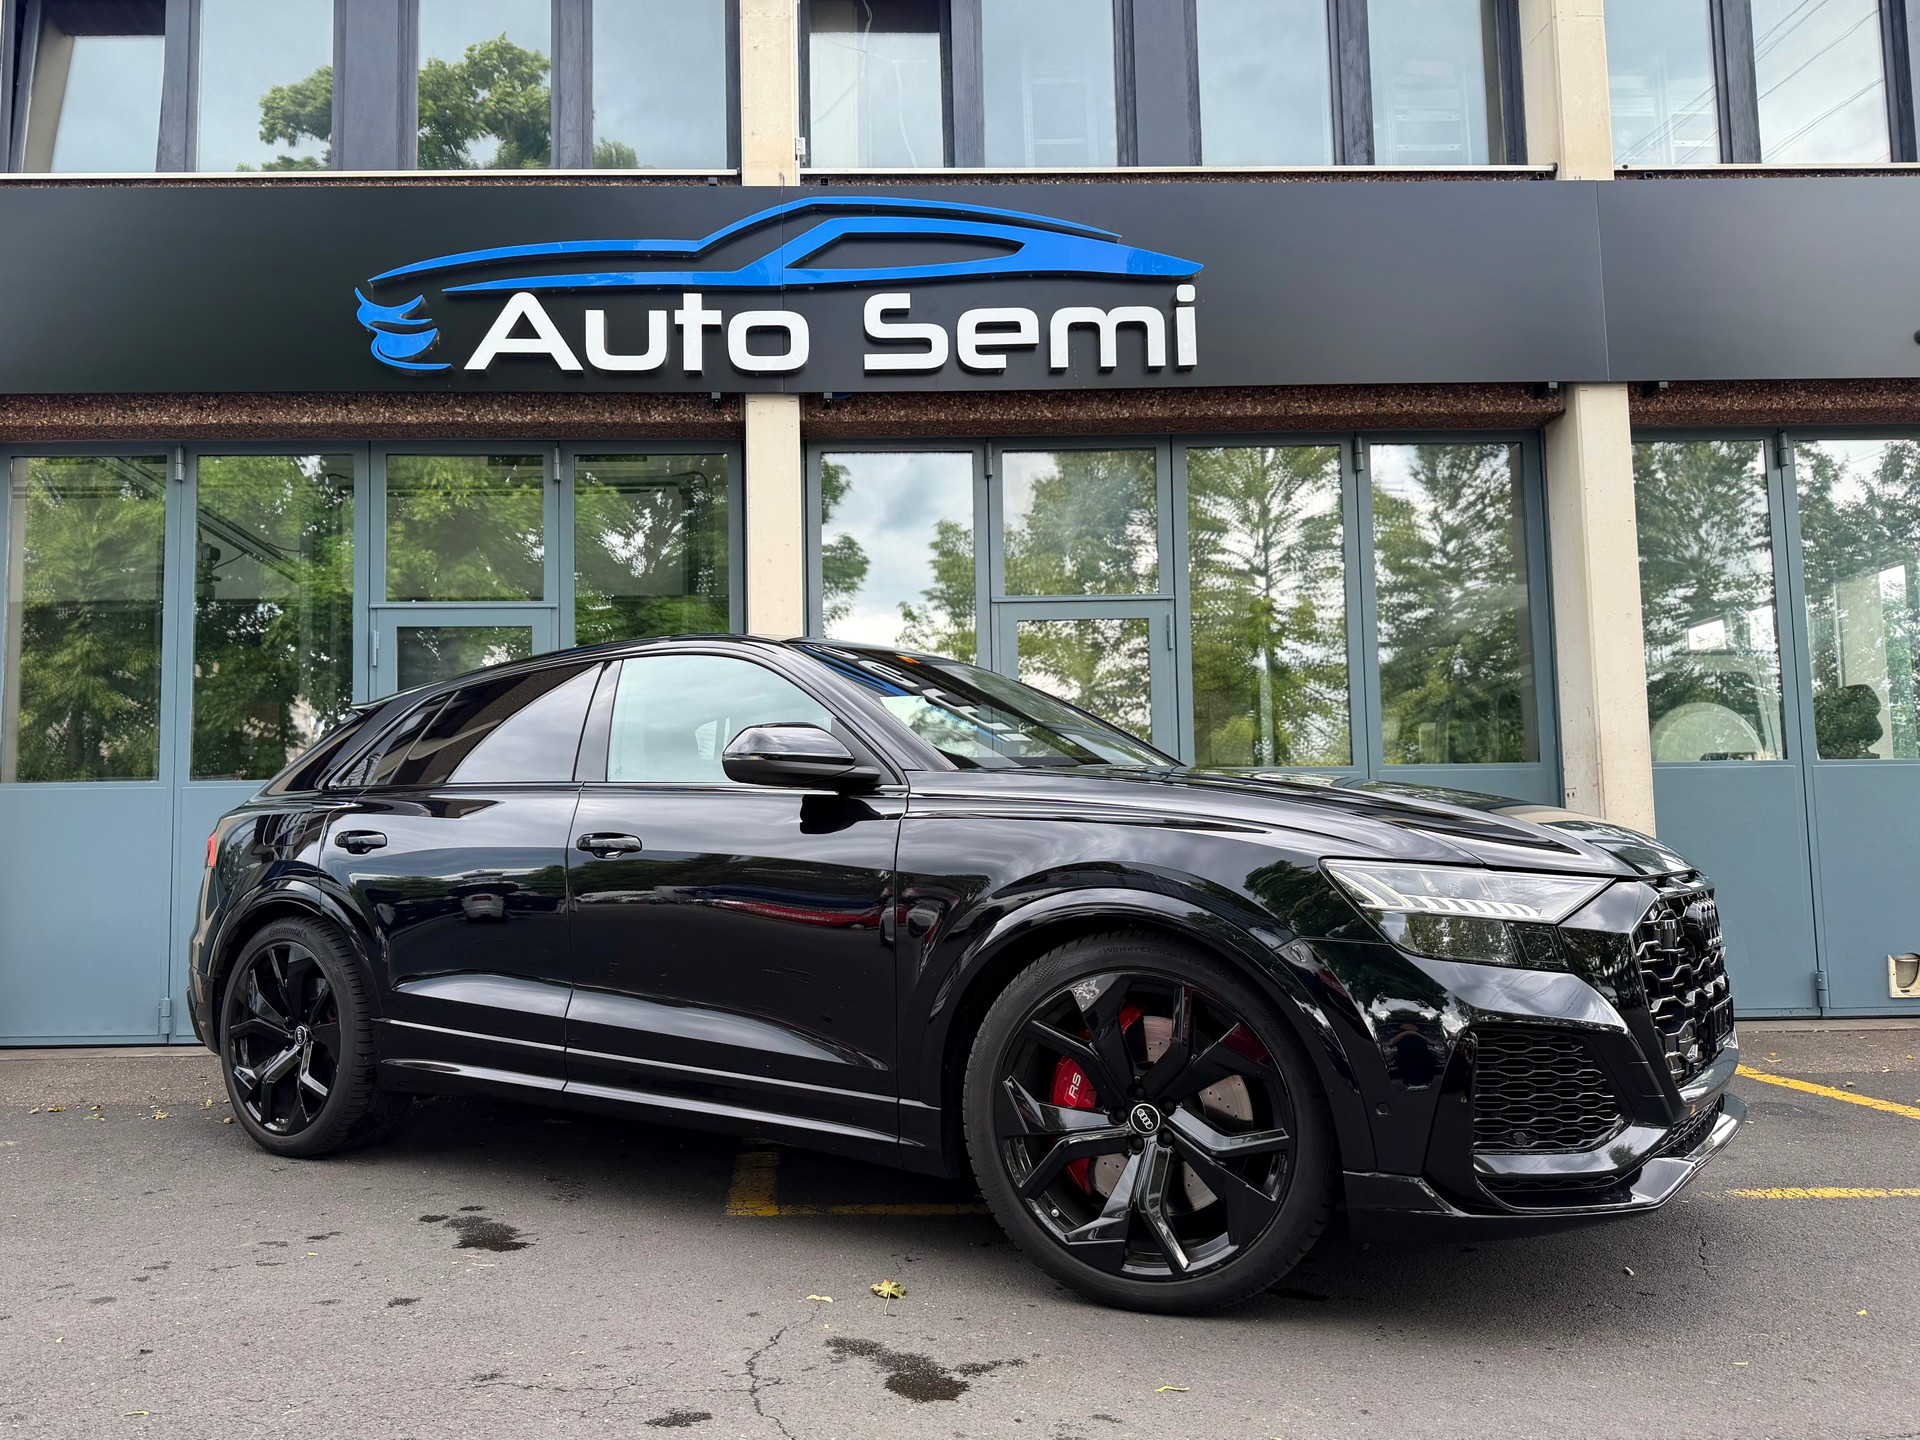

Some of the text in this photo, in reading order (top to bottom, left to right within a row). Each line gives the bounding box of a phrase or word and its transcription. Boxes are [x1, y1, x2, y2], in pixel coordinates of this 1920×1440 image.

[464, 285, 1198, 371] Auto Semi
[1068, 1071, 1082, 1100] RS
